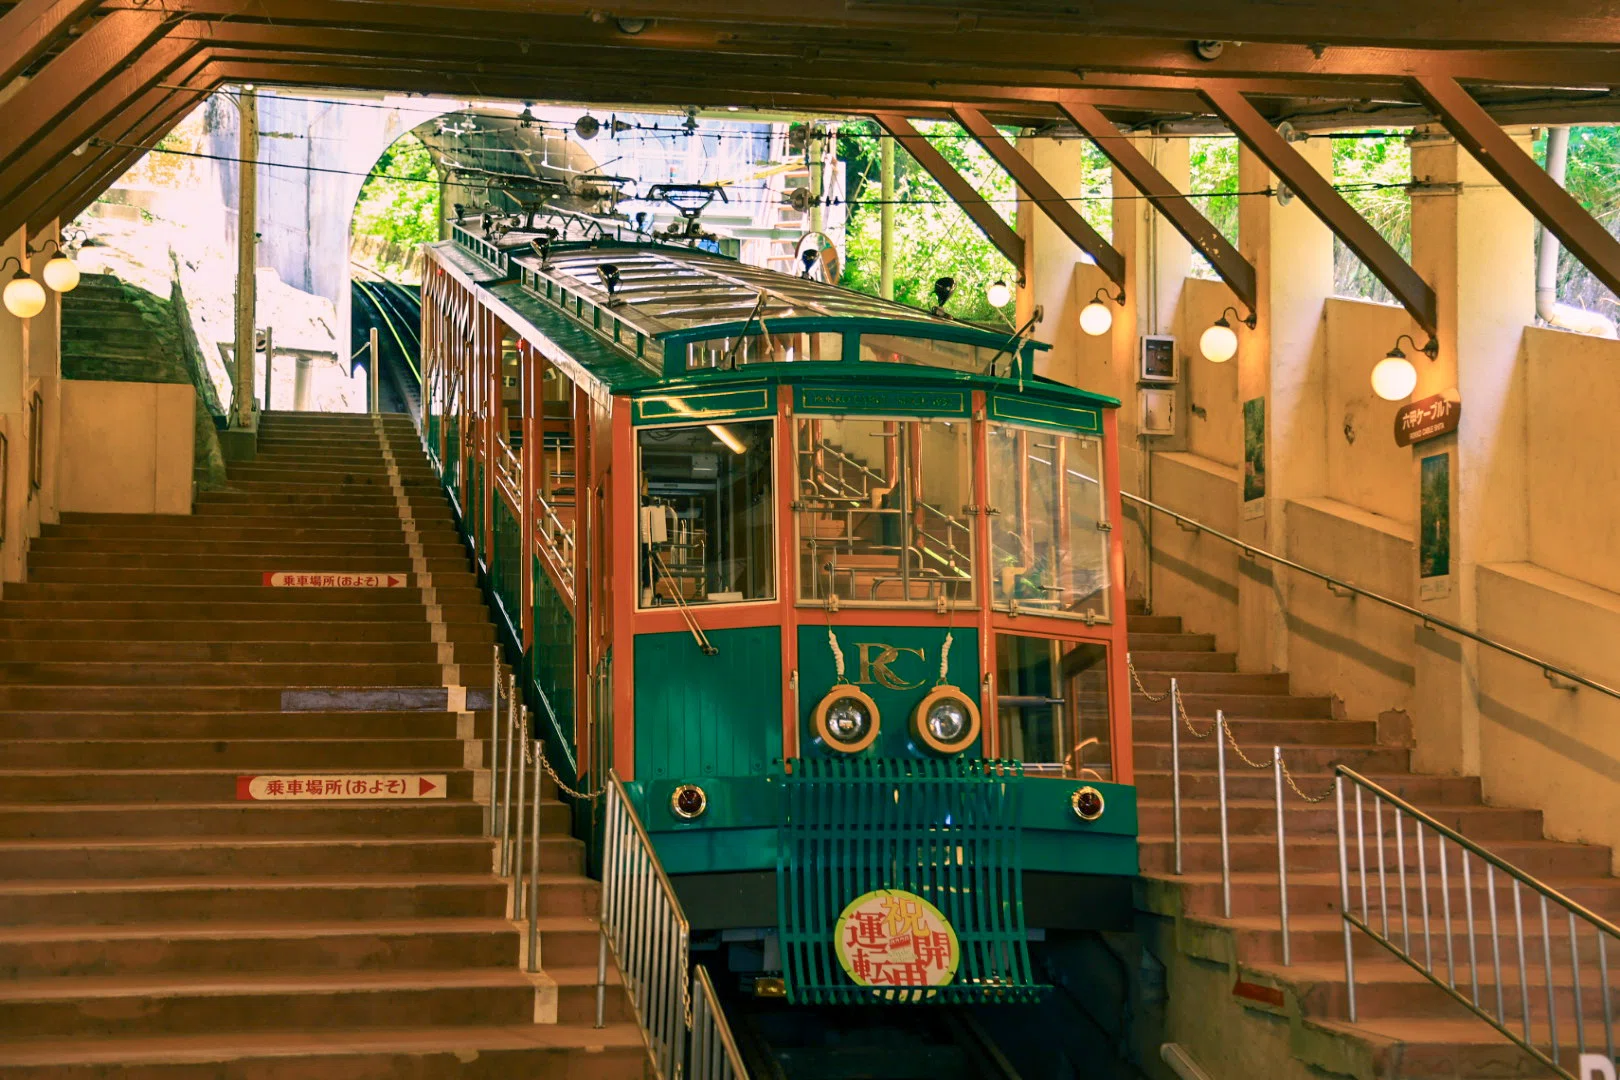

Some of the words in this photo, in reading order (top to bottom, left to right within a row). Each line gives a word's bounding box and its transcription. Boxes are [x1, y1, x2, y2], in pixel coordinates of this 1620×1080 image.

[1402, 399, 1452, 431] 六甲ケーブル下
[282, 575, 379, 587] 乗車場所(およそ)
[266, 778, 406, 796] 乗車場所(およそ)
[880, 896, 931, 937] 祝
